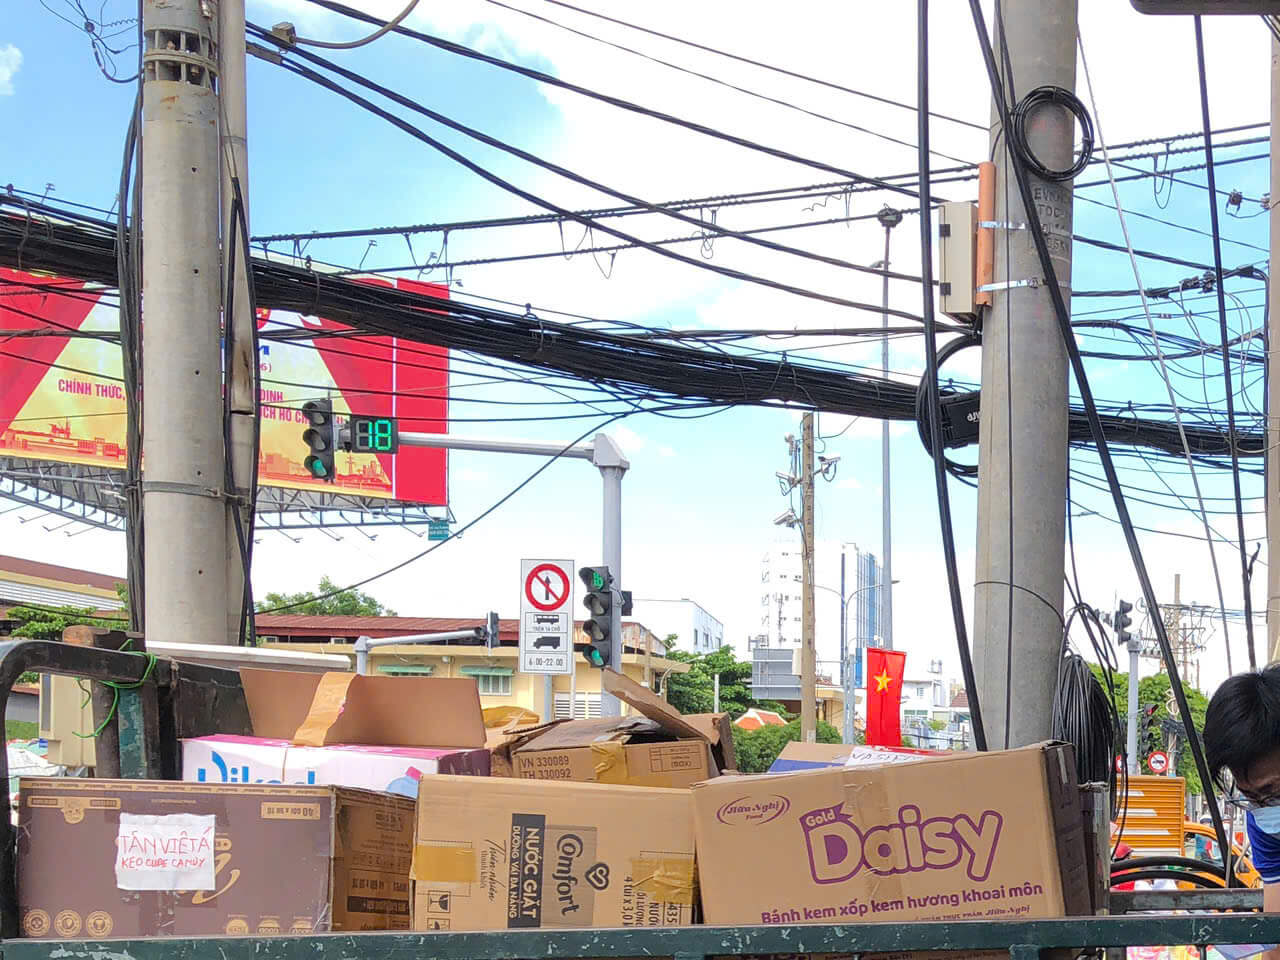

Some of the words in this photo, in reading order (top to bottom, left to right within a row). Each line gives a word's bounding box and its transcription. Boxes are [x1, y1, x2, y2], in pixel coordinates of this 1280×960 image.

[58, 378, 92, 396] CHÍNH
[367, 420, 392, 450] 18
[521, 757, 534, 768] VN
[537, 755, 569, 768] 330089
[805, 809, 836, 827] Gold
[524, 827, 543, 876] NƯỚC
[803, 804, 1003, 885] Daisy
[552, 834, 584, 916] Comfort
[520, 879, 541, 919] GIẶT
[761, 908, 800, 924] Bánh
[803, 906, 836, 920] kem
[840, 898, 868, 917] xốp
[871, 898, 904, 914] kem
[907, 892, 960, 909] hương
[962, 885, 1005, 903] khoai
[1008, 882, 1043, 898] môn
